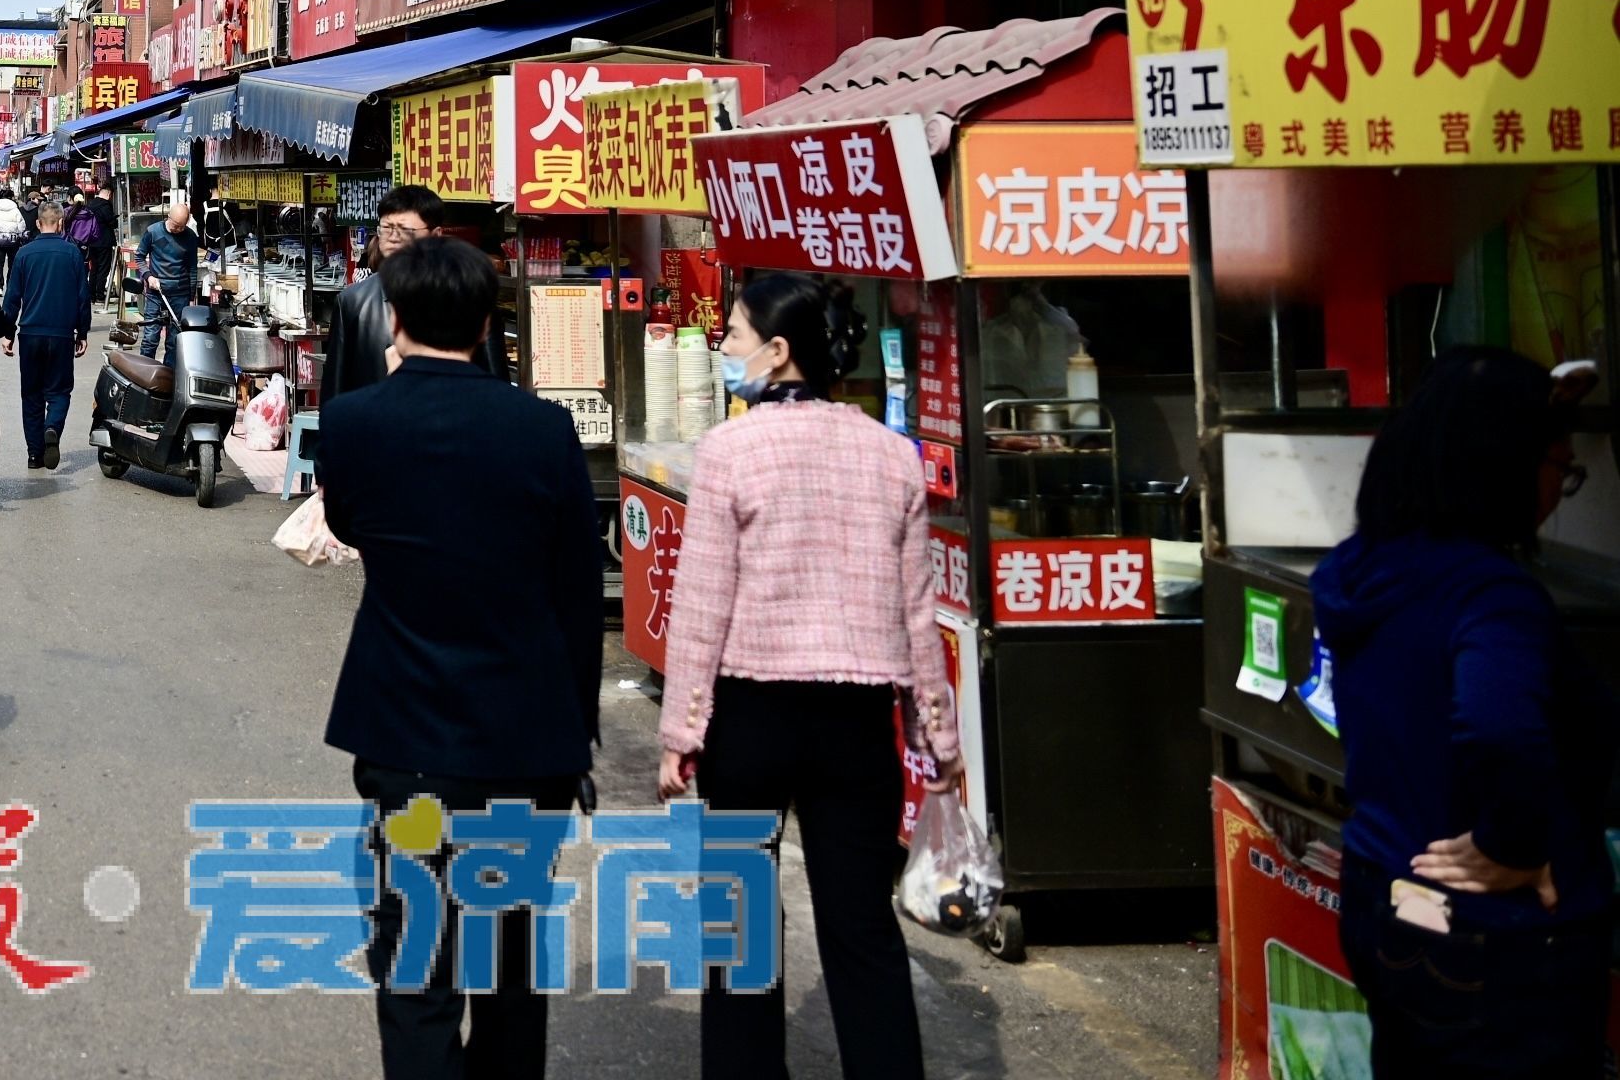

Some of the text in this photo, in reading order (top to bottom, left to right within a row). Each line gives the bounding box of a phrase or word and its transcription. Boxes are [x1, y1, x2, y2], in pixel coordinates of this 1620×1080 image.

[1146, 65, 1223, 118] 招工
[1244, 107, 1620, 158] 粤式美味 营养健
[791, 132, 883, 198] 凉皮
[706, 160, 794, 240] 小俩口
[796, 206, 913, 273] 卷凉皮
[996, 549, 1146, 612] 卷凉皮
